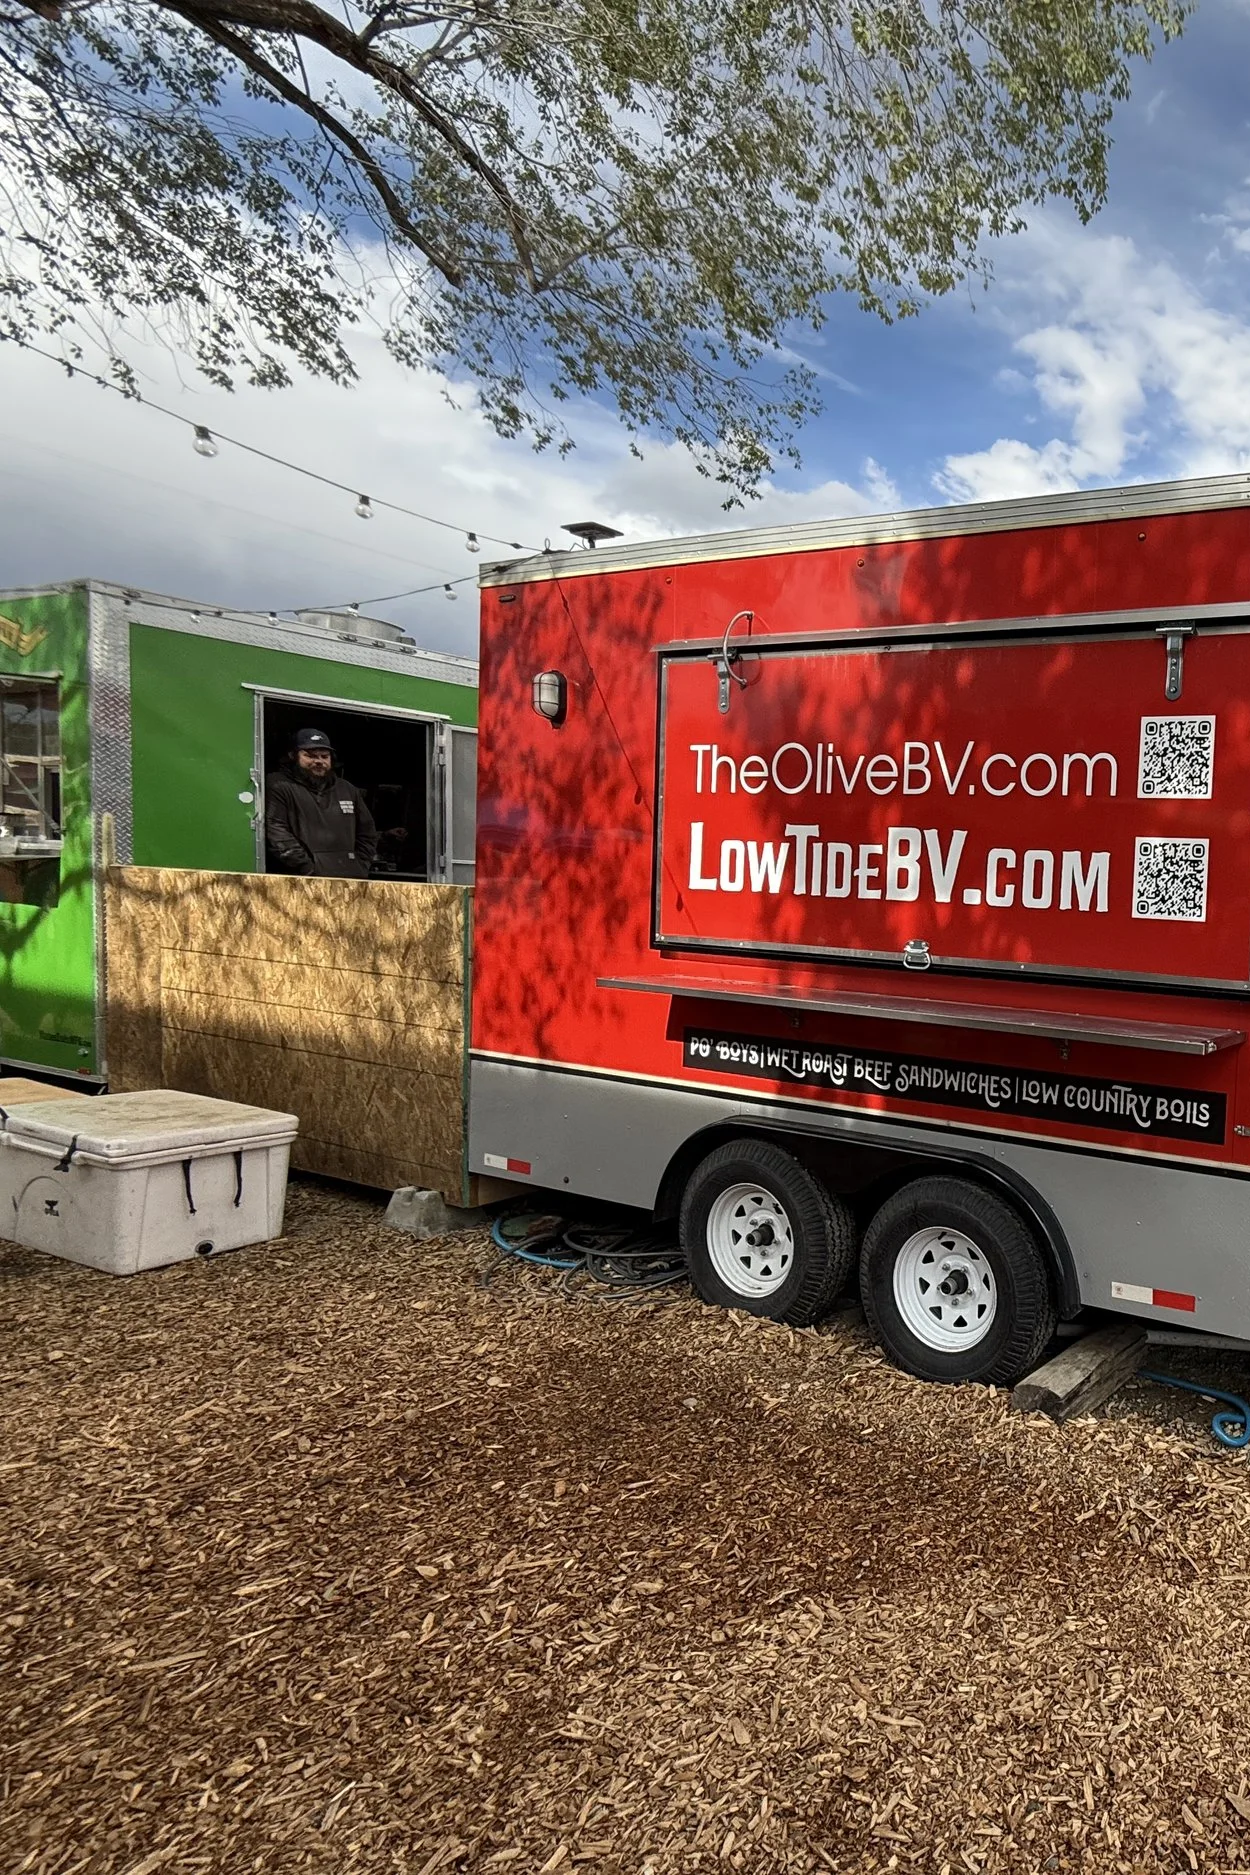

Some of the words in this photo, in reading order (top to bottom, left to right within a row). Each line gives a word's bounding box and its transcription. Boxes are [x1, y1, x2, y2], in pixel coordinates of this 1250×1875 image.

[690, 741, 1118, 797] TheOliveBV.com
[690, 1036, 714, 1057] PO'
[802, 1051, 853, 1085] ROAST
[853, 1058, 893, 1090] BEEF
[895, 1063, 1012, 1108] SANDWICHES
[1022, 1080, 1060, 1105] LOW
[1063, 1084, 1152, 1128] COUNTRY
[1155, 1097, 1210, 1128] BOILS
